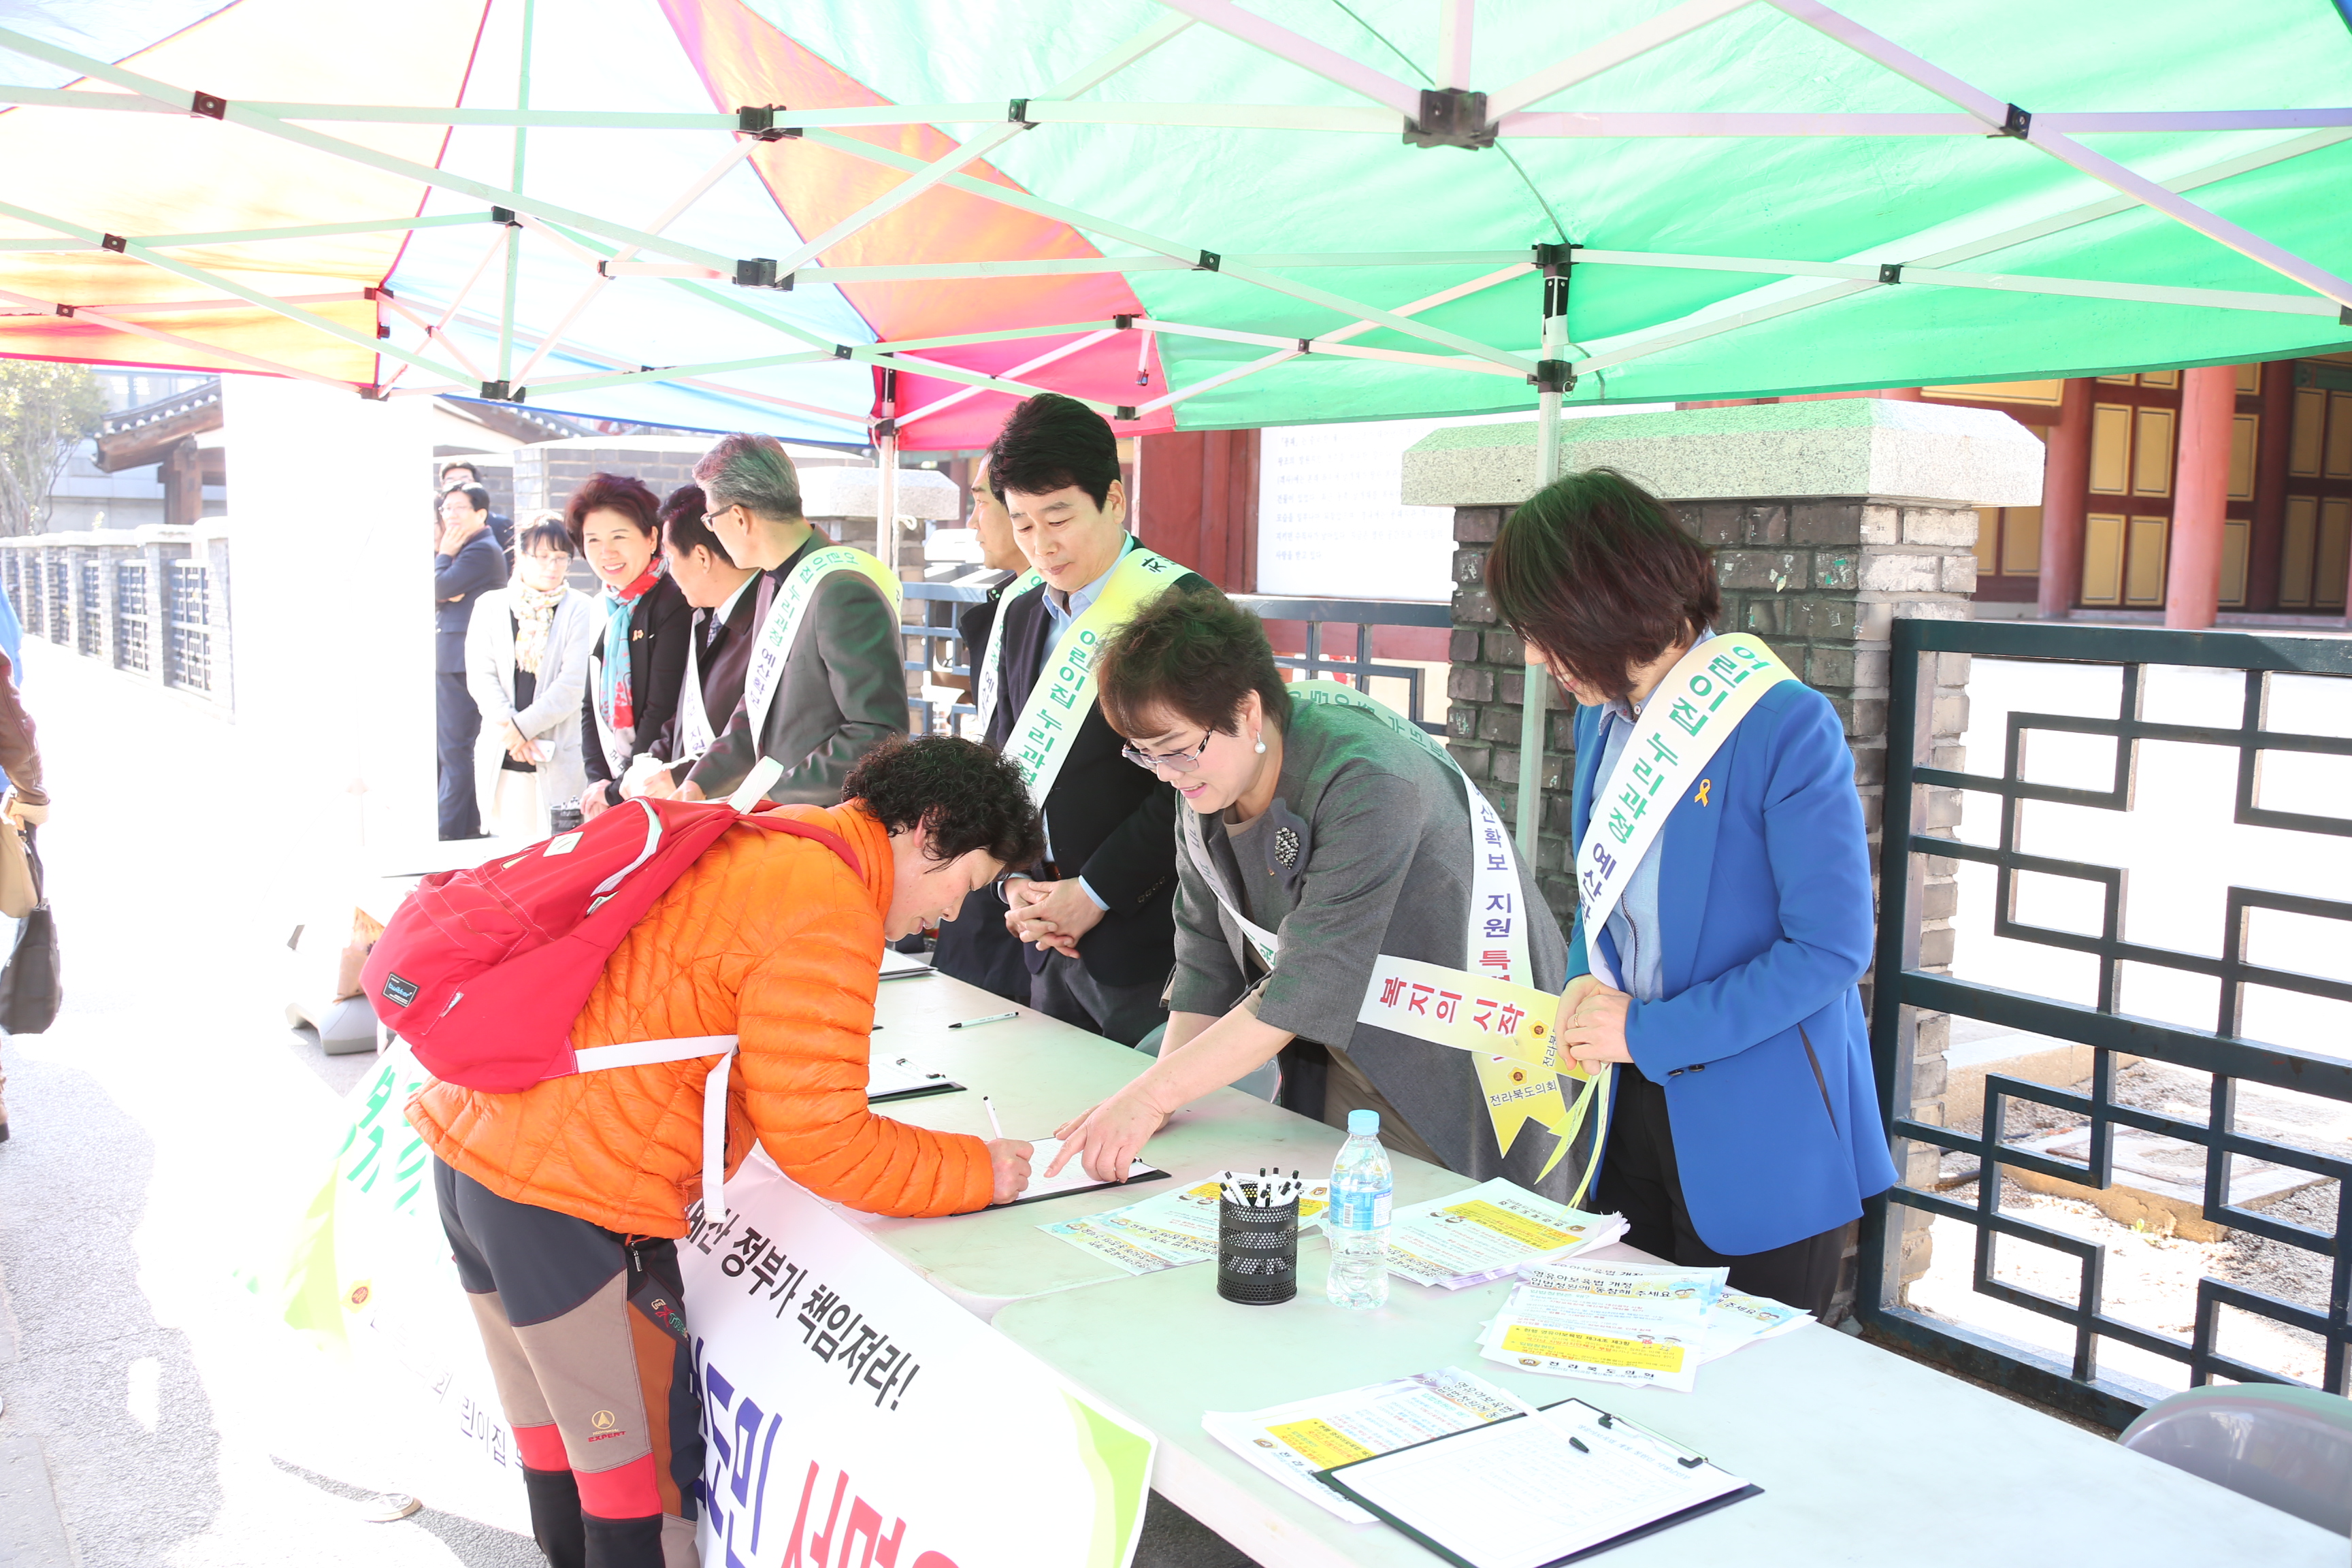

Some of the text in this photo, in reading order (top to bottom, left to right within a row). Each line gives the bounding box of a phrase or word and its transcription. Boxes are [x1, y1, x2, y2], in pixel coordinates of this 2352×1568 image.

[799, 551, 859, 584] 어린이집
[769, 584, 800, 647] 누리과정
[1669, 645, 1772, 737] 어린이집
[1607, 732, 1678, 845] 누리과정
[1484, 893, 1512, 938] 지원
[1479, 950, 1512, 981] 특
[1379, 977, 1526, 1036] 복지의 시작
[1489, 1079, 1558, 1107] 전라북도의회
[1530, 1277, 1671, 1298] 입법청원에 동참해 주세요
[1533, 1270, 1633, 1289] 영유아보육법 개정
[721, 1226, 808, 1319] 정부가
[797, 1284, 921, 1411] 책임져라!
[1723, 1301, 1757, 1315] 주세요
[1540, 1329, 1583, 1340] 영유아보육법
[1586, 1334, 1609, 1343] 제34조
[1437, 1385, 1492, 1413] 입법청원에
[1454, 1381, 1516, 1413] 영유아보육법
[460, 1395, 506, 1468] 린이집
[588, 1431, 626, 1443] EXPERT
[689, 1335, 783, 1568] 도민
